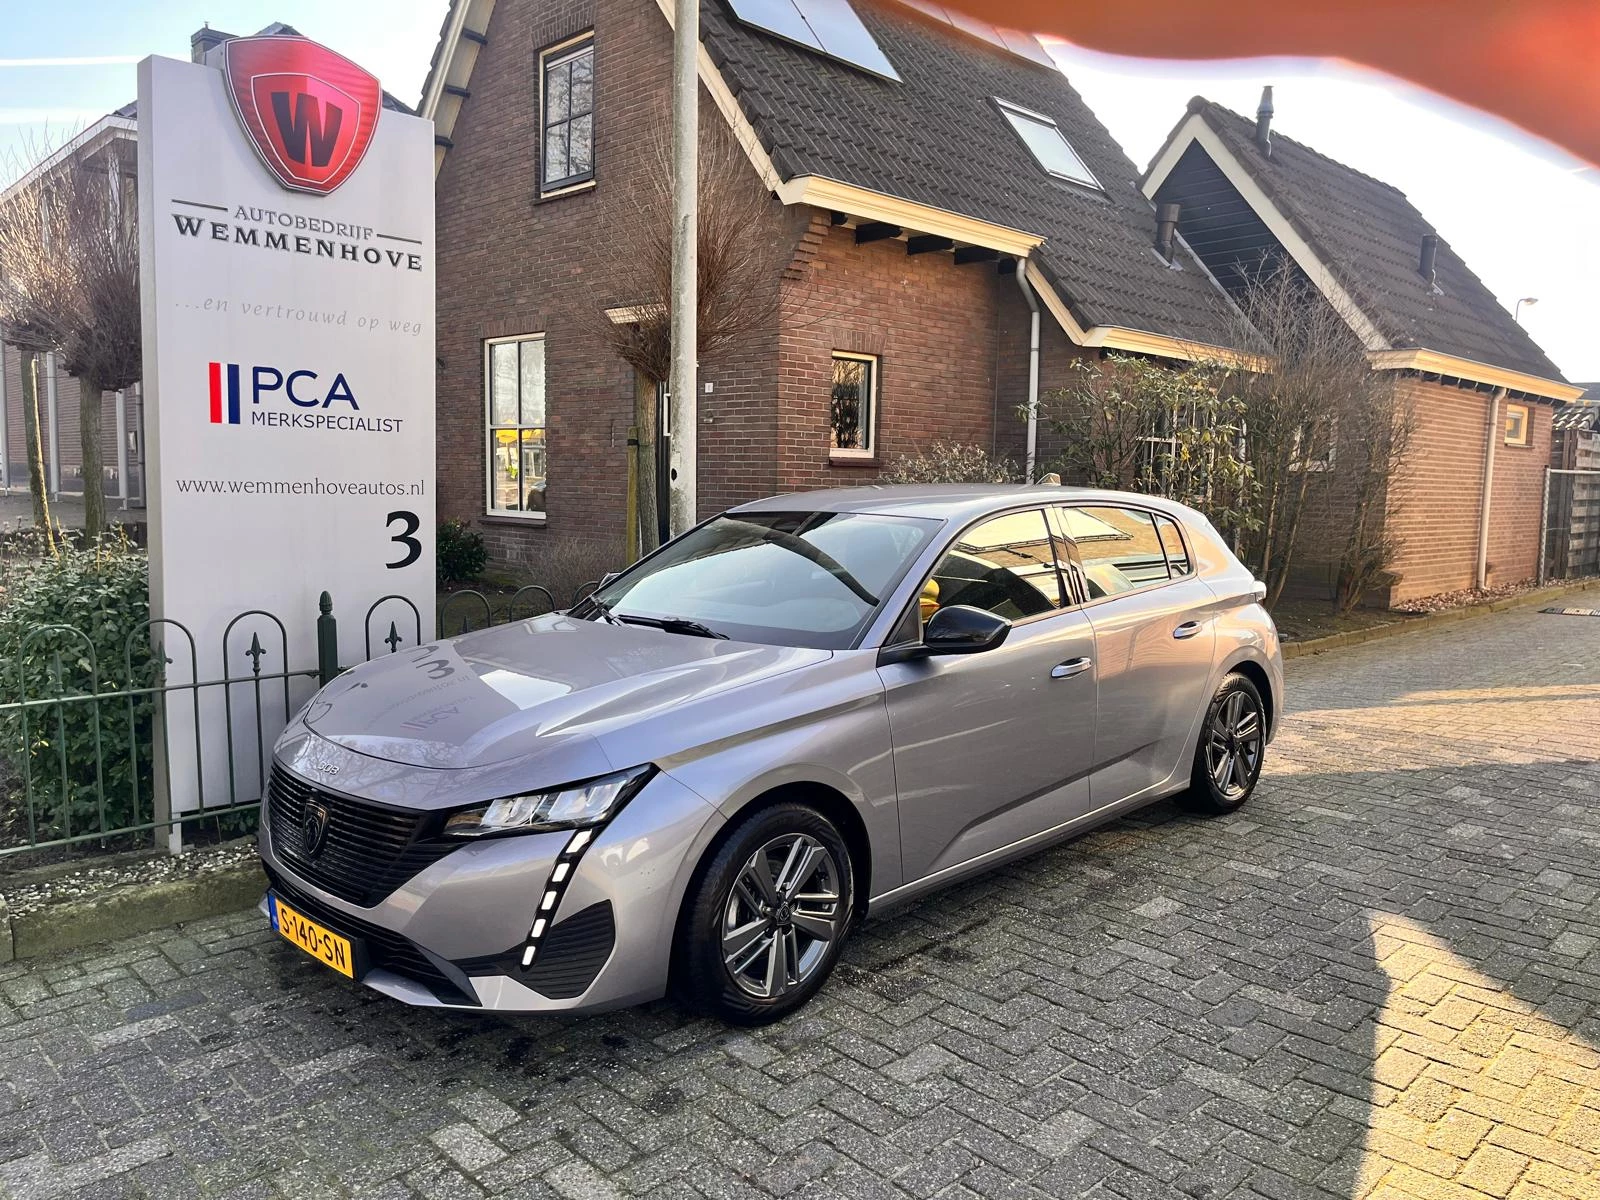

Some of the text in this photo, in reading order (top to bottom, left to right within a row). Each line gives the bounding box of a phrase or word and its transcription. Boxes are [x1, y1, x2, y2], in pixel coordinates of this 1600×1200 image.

[270, 91, 343, 168] W
[172, 213, 423, 272] WEMMENHOVE
[234, 205, 374, 241] AUTOBEDRIJF
[241, 302, 347, 326] vertrouwd
[357, 315, 380, 332] op
[389, 319, 422, 337] weg
[252, 366, 360, 411] PCA
[251, 411, 403, 433] MERKSPECIALIST
[175, 477, 425, 496] www.wemmenhoveautos.nl
[385, 510, 423, 570] 3
[281, 907, 346, 969] S-140-SN
